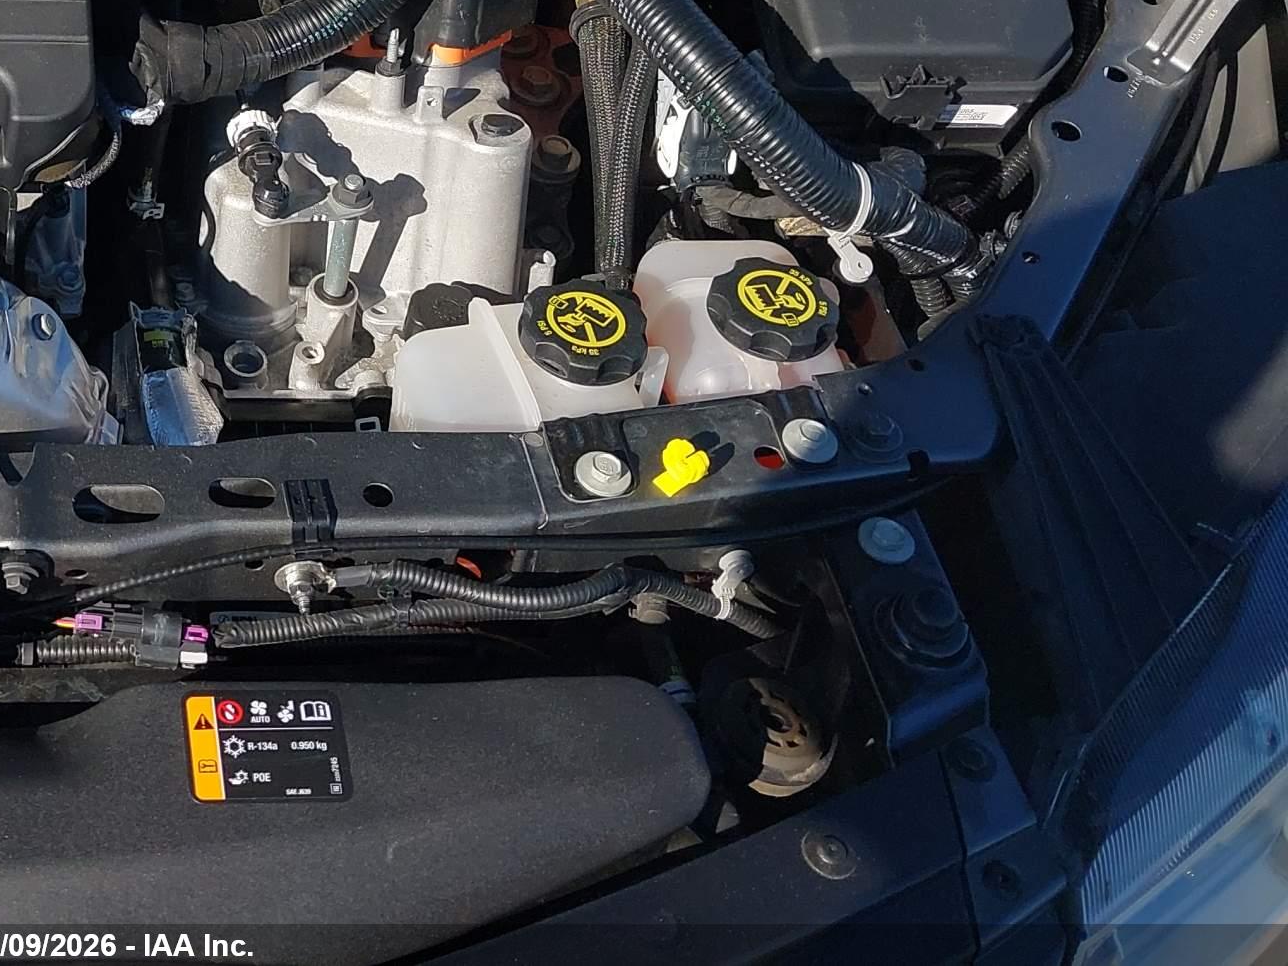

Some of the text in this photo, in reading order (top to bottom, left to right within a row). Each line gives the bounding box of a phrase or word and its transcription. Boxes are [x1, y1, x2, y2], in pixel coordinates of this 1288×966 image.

[250, 715, 270, 723] AUTO
[247, 742, 278, 751] R-134a
[291, 741, 327, 751] 0.950 kg
[253, 772, 271, 783] POE
